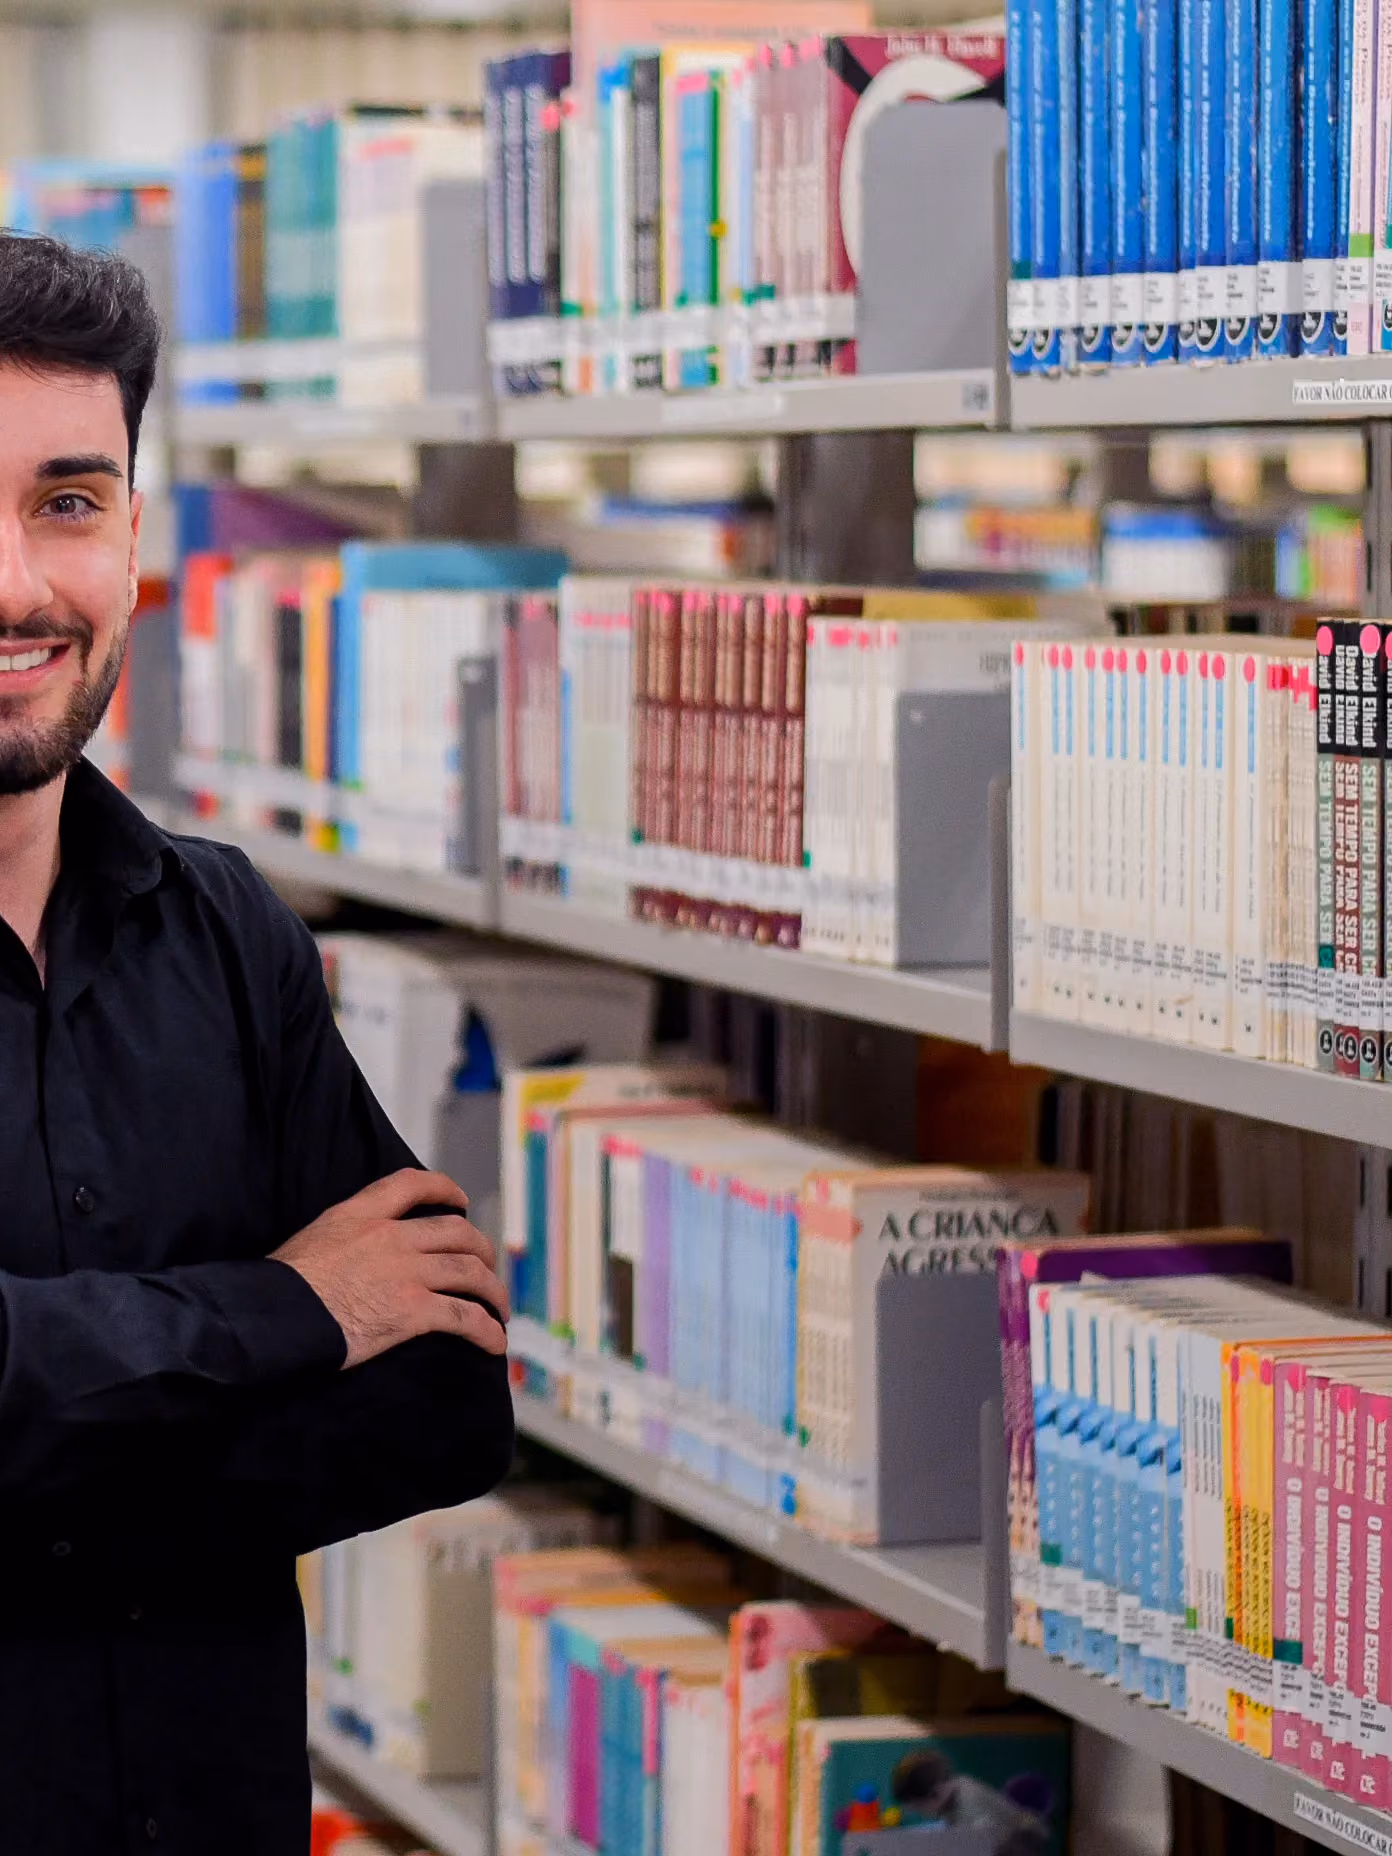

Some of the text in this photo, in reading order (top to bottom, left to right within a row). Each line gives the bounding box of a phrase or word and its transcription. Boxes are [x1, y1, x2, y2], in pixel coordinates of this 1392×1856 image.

[1324, 381, 1344, 401] NÃO
[1344, 383, 1388, 401] COLOCAR
[1319, 655, 1331, 744] avid Elkind
[1345, 645, 1359, 746] David Elkind
[1362, 697, 1377, 748] Elkind
[1345, 763, 1358, 800] SEM
[1362, 765, 1377, 801] SEM
[1345, 804, 1358, 862] TEMPO
[1362, 805, 1377, 864] TEMPO
[1345, 867, 1358, 910] PARA
[1362, 869, 1377, 912] PARA
[1345, 915, 1358, 949] SER
[1362, 919, 1377, 950] SER
[879, 1210, 900, 1241] A
[1337, 1505, 1352, 1518] O
[1367, 1516, 1382, 1530] O
[1335, 1522, 1354, 1617] INDIVÍDUO
[1364, 1534, 1384, 1629] INDIVÍDUO
[1344, 1822, 1388, 1854] COLOCAR
